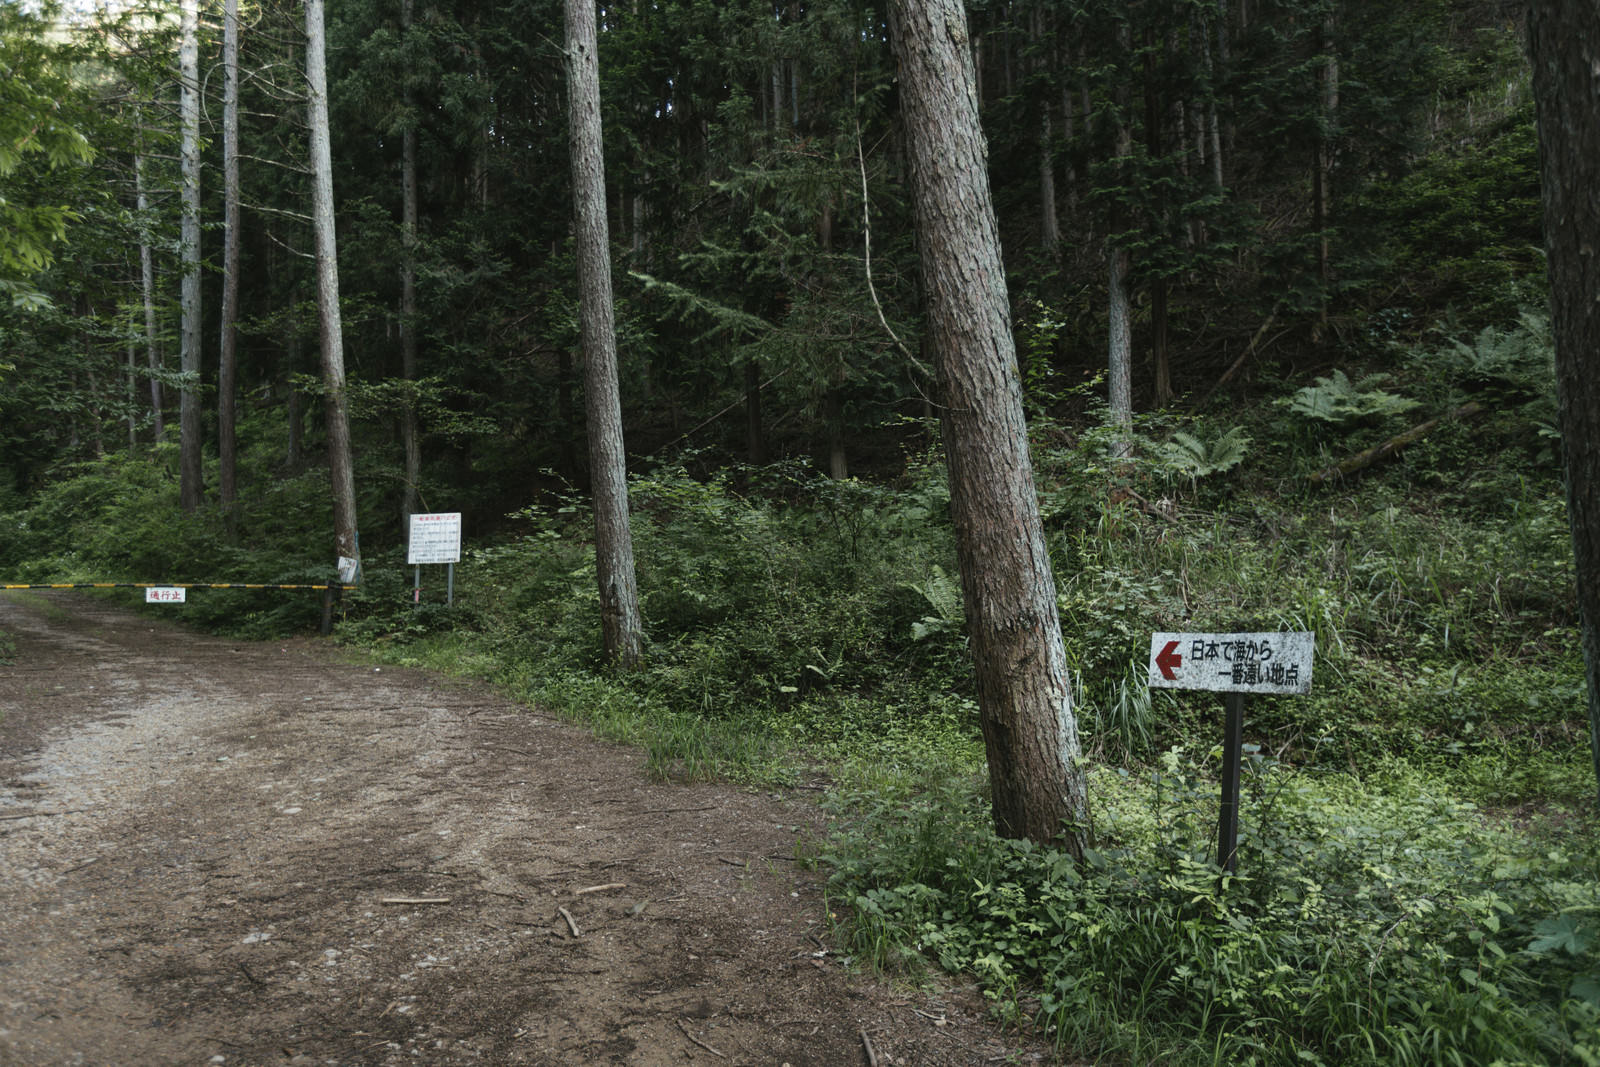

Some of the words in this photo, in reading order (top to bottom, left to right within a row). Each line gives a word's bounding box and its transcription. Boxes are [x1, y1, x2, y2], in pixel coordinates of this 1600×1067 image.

[1191, 639, 1272, 661] 日本で海から
[1218, 663, 1299, 686] 一番遠い地点
